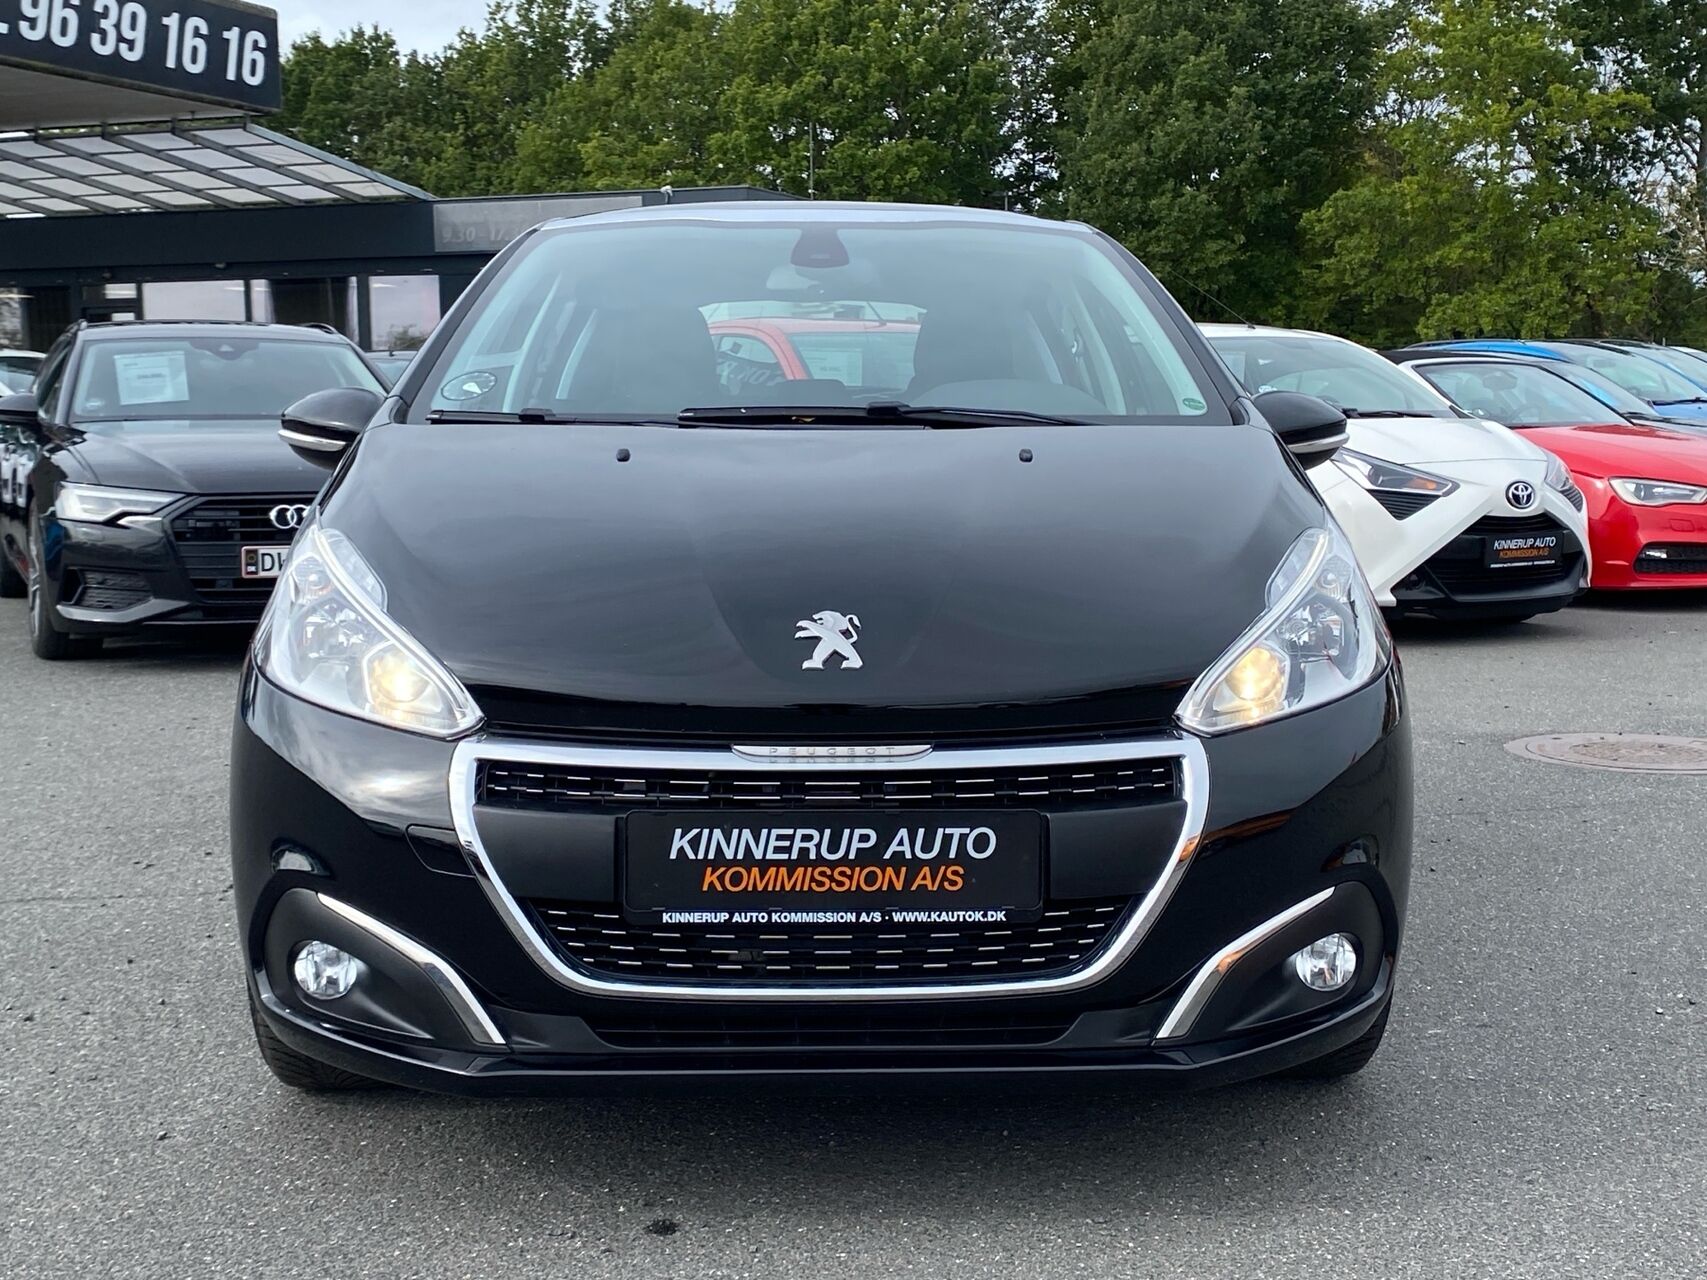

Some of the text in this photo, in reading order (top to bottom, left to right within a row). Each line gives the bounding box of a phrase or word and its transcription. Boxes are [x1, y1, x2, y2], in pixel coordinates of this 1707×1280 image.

[18, 0, 267, 87] 96 39 16 16
[1494, 536, 1556, 550] KINNERUP AUTO
[768, 747, 896, 755] PEUGEOT
[669, 826, 997, 861] KINNERUP AUTO
[702, 865, 965, 892] KOMMISSION A/S
[662, 912, 729, 923] KINNERUP
[732, 912, 768, 923] AUTO
[771, 912, 856, 923] KOMMISSION
[859, 912, 881, 922] A/S
[892, 910, 1007, 922] WWW.KAUTOK.DK
